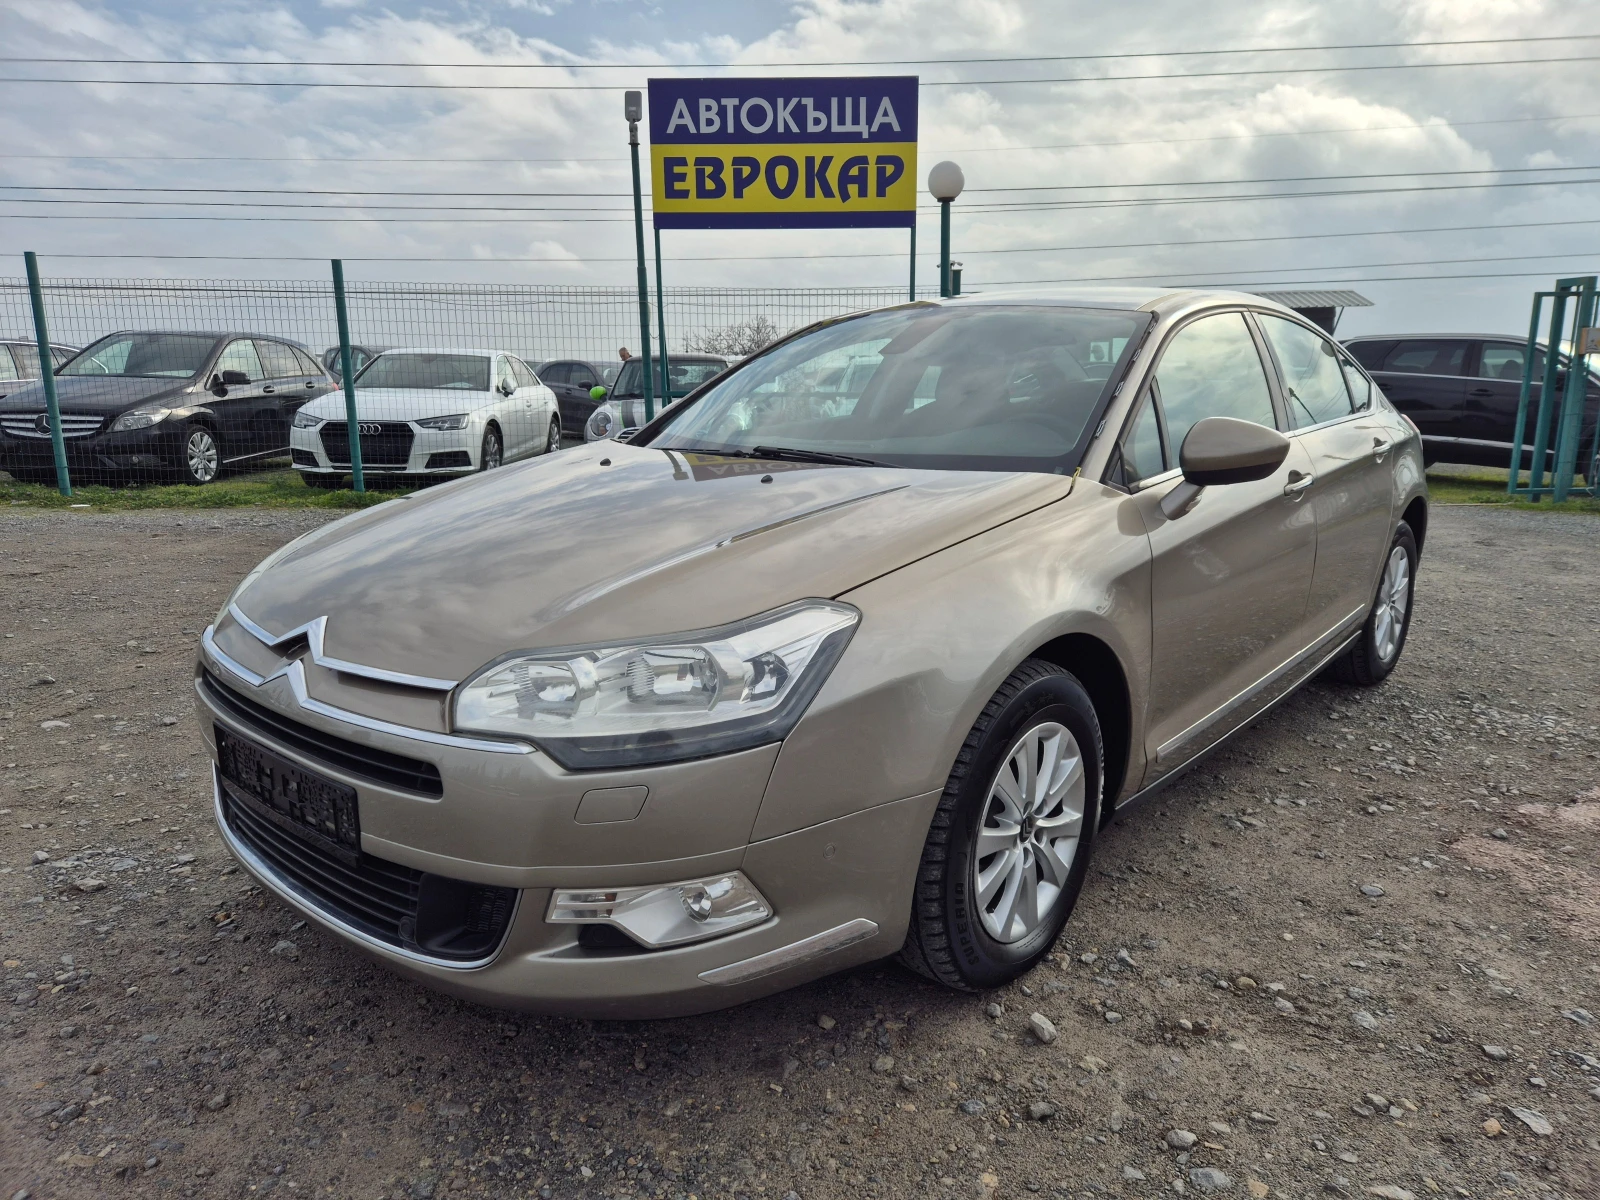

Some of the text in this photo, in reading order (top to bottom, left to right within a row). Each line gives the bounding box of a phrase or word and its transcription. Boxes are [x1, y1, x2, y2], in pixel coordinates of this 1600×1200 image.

[666, 96, 901, 139] АВТОКЪЩА
[663, 155, 905, 204] ЕВРОКАР
[954, 882, 981, 966] SUPERIA
